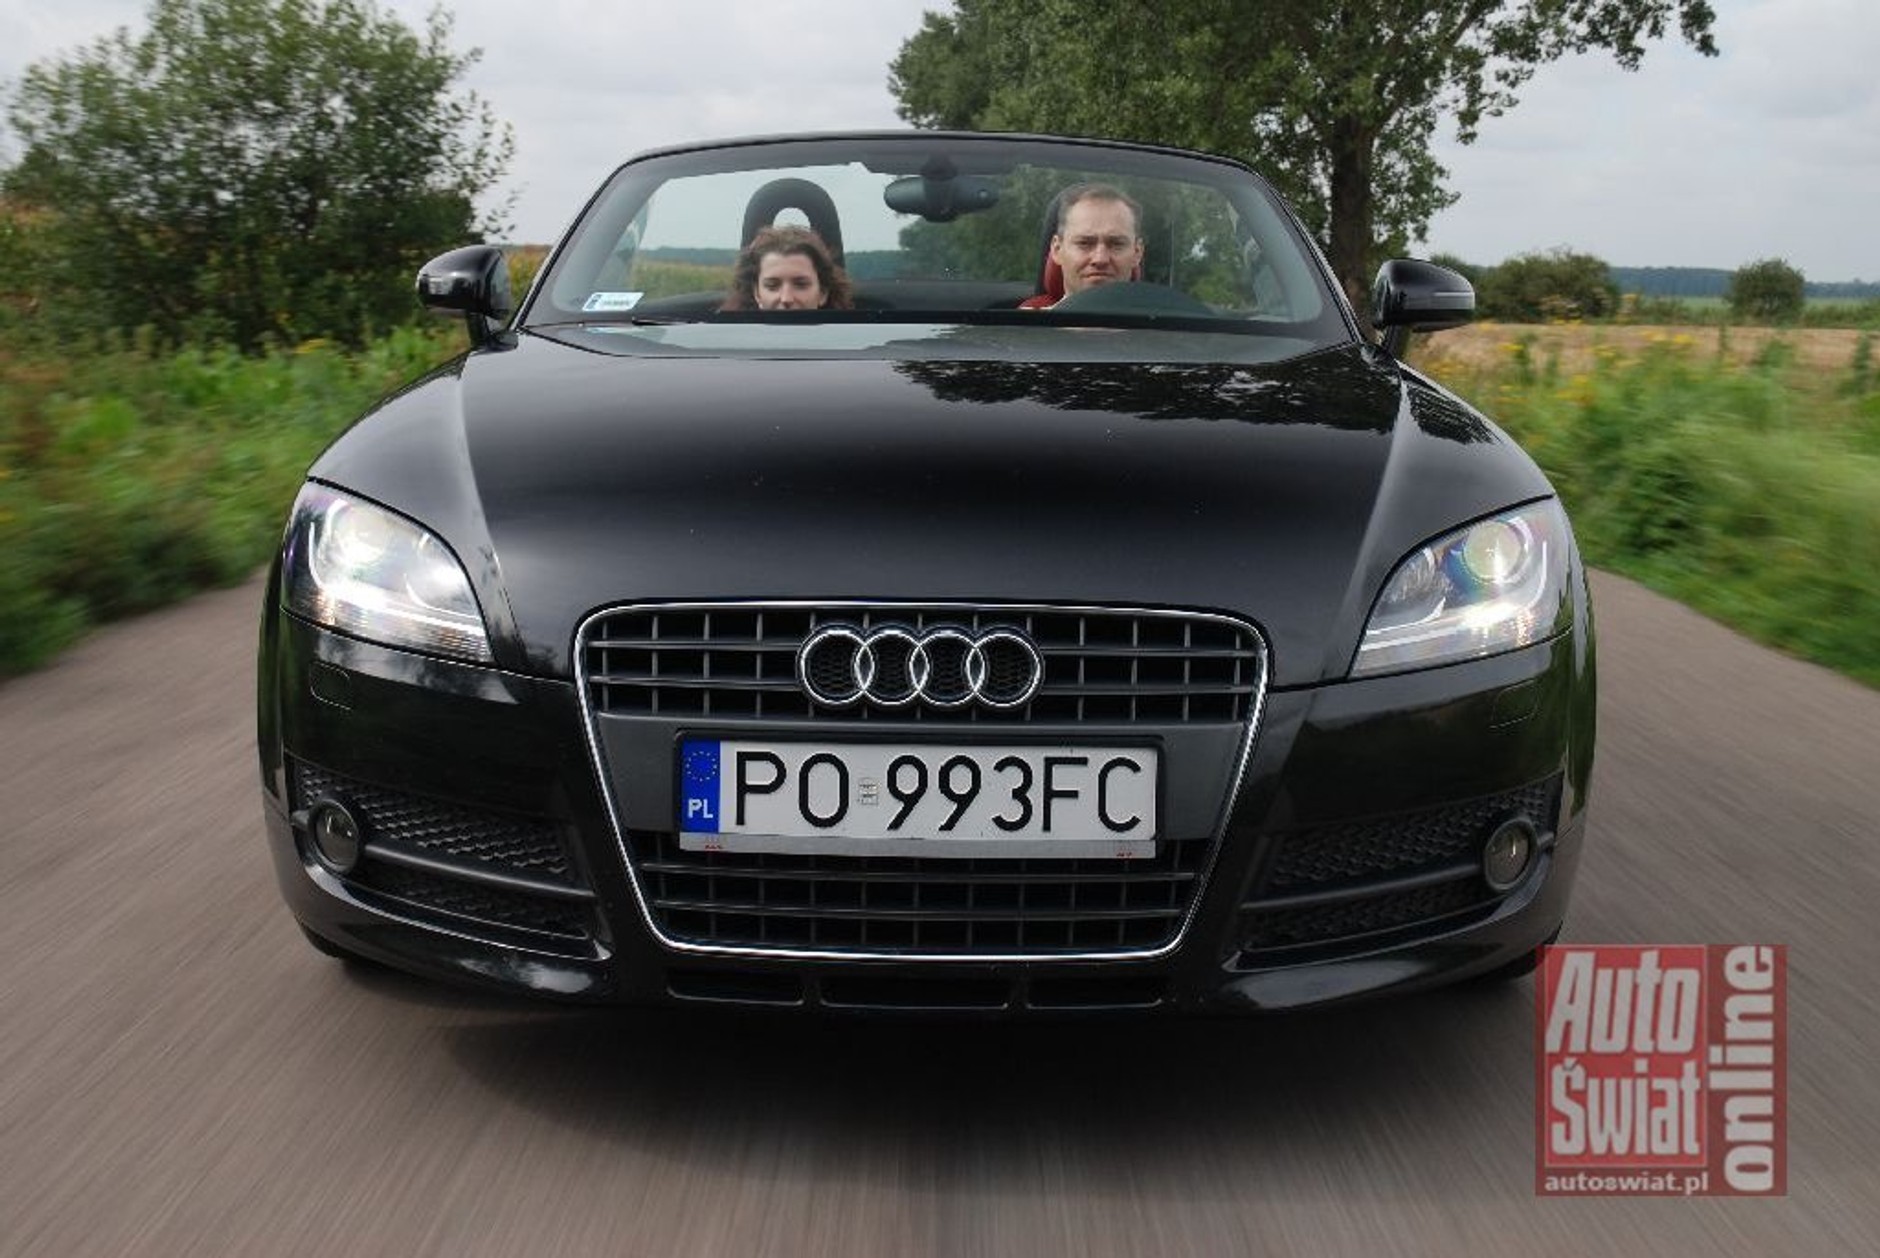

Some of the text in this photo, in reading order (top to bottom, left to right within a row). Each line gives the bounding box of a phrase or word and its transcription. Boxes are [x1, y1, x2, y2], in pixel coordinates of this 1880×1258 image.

[688, 799, 713, 819] PL
[735, 751, 1142, 832] PO 993FC
